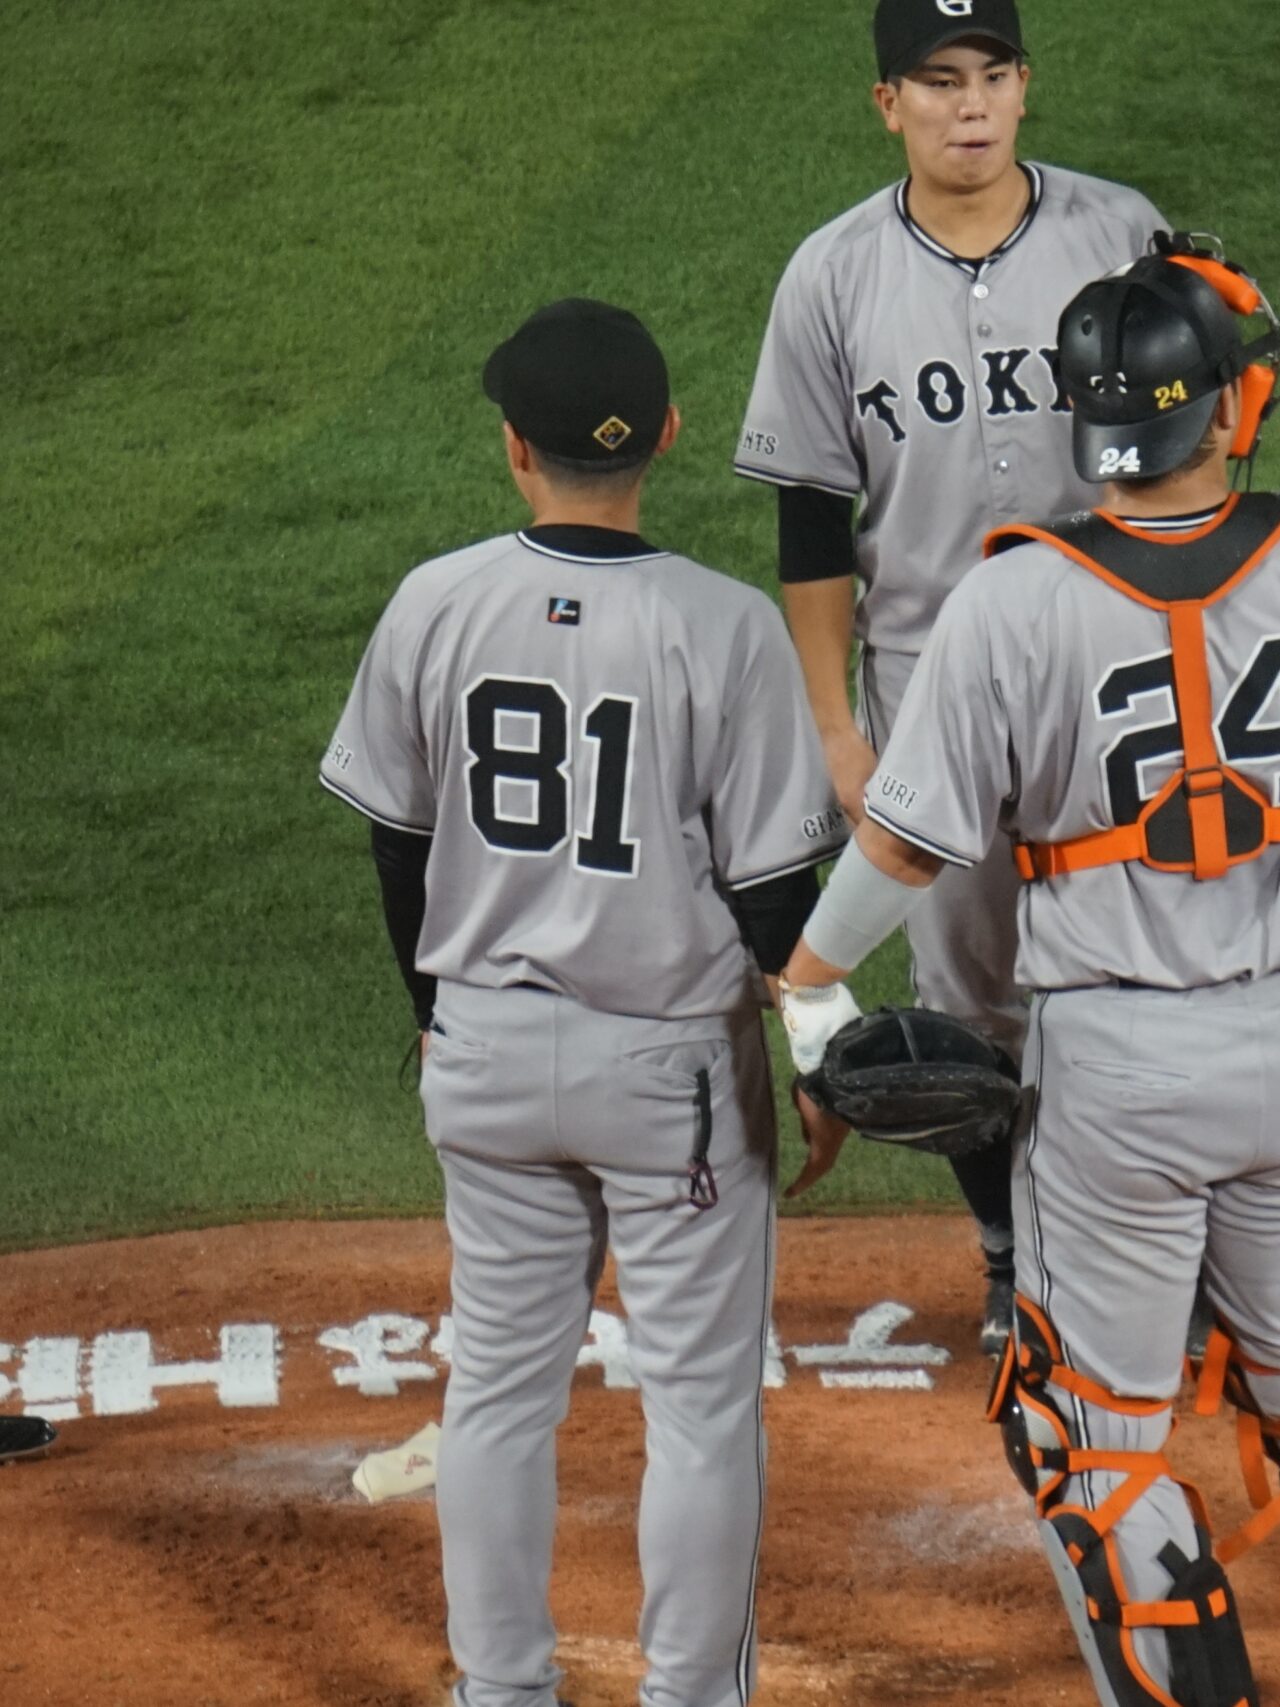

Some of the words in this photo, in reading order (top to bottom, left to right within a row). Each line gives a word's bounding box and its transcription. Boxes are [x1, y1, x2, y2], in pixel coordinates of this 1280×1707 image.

[1153, 379, 1189, 410] 24
[742, 428, 778, 456] NTS
[1097, 446, 1141, 475] 24
[461, 673, 641, 879] 81
